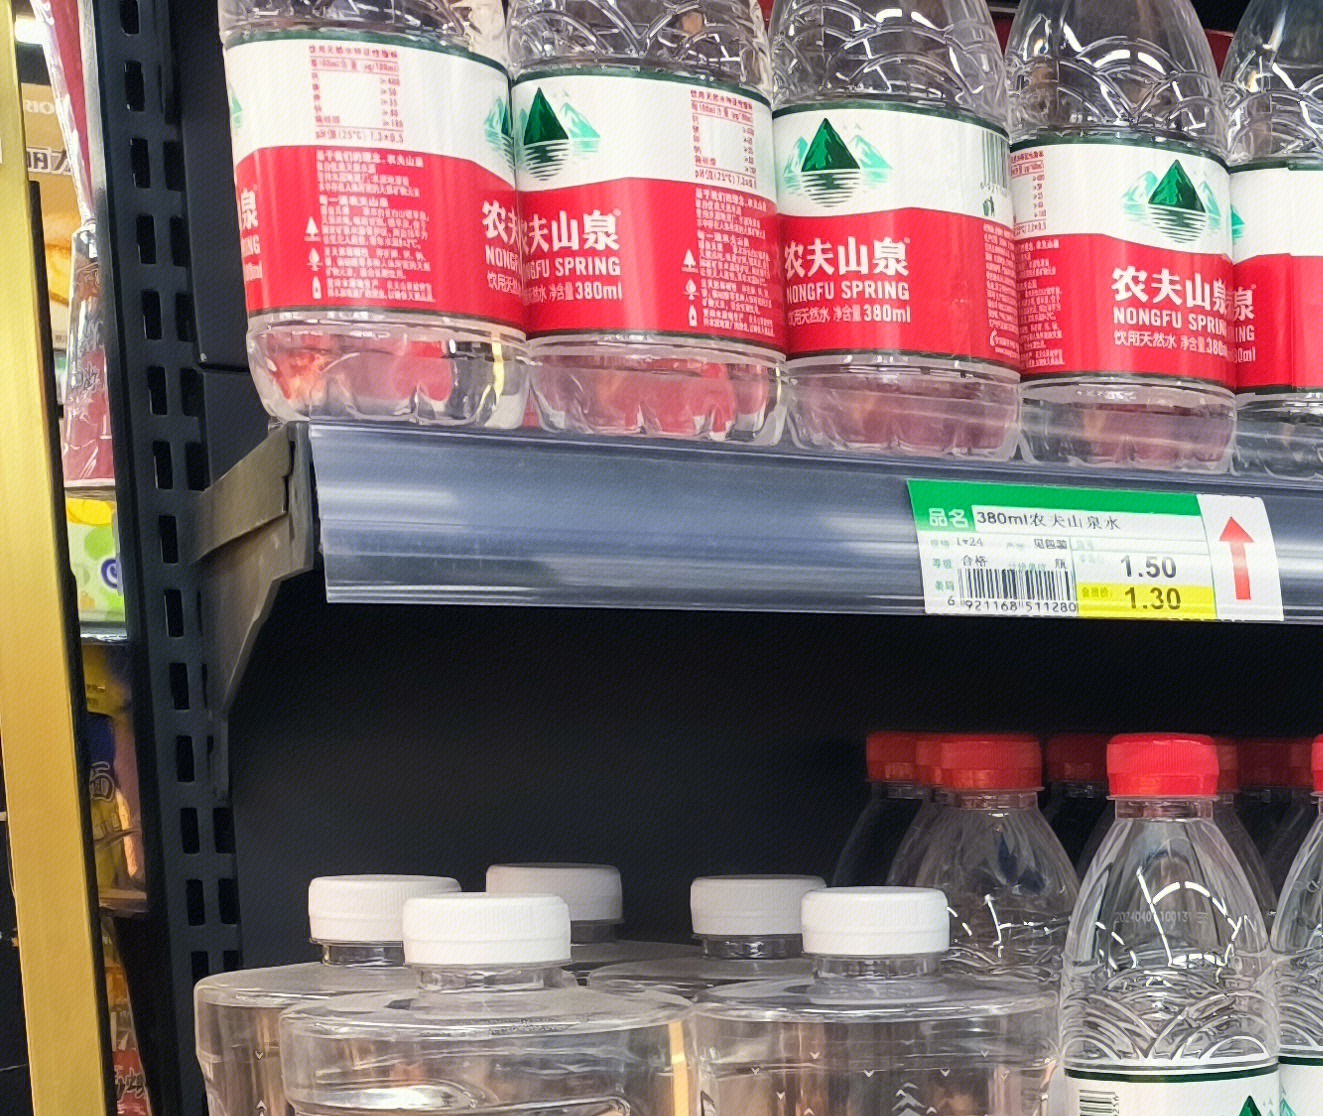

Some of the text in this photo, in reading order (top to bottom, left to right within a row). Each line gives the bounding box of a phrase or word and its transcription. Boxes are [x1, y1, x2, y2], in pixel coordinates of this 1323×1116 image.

[555, 257, 621, 277] SPRING
[785, 236, 909, 280] 农夫山泉
[787, 281, 910, 304] NONGFU SPRING
[1113, 307, 1227, 337] NONGFU SPRIN
[1114, 330, 1177, 350] 饮用天然水
[1234, 325, 1254, 343] ING
[928, 507, 970, 529] 品名
[1120, 555, 1177, 579] 1.50
[1125, 587, 1181, 610] 1.30
